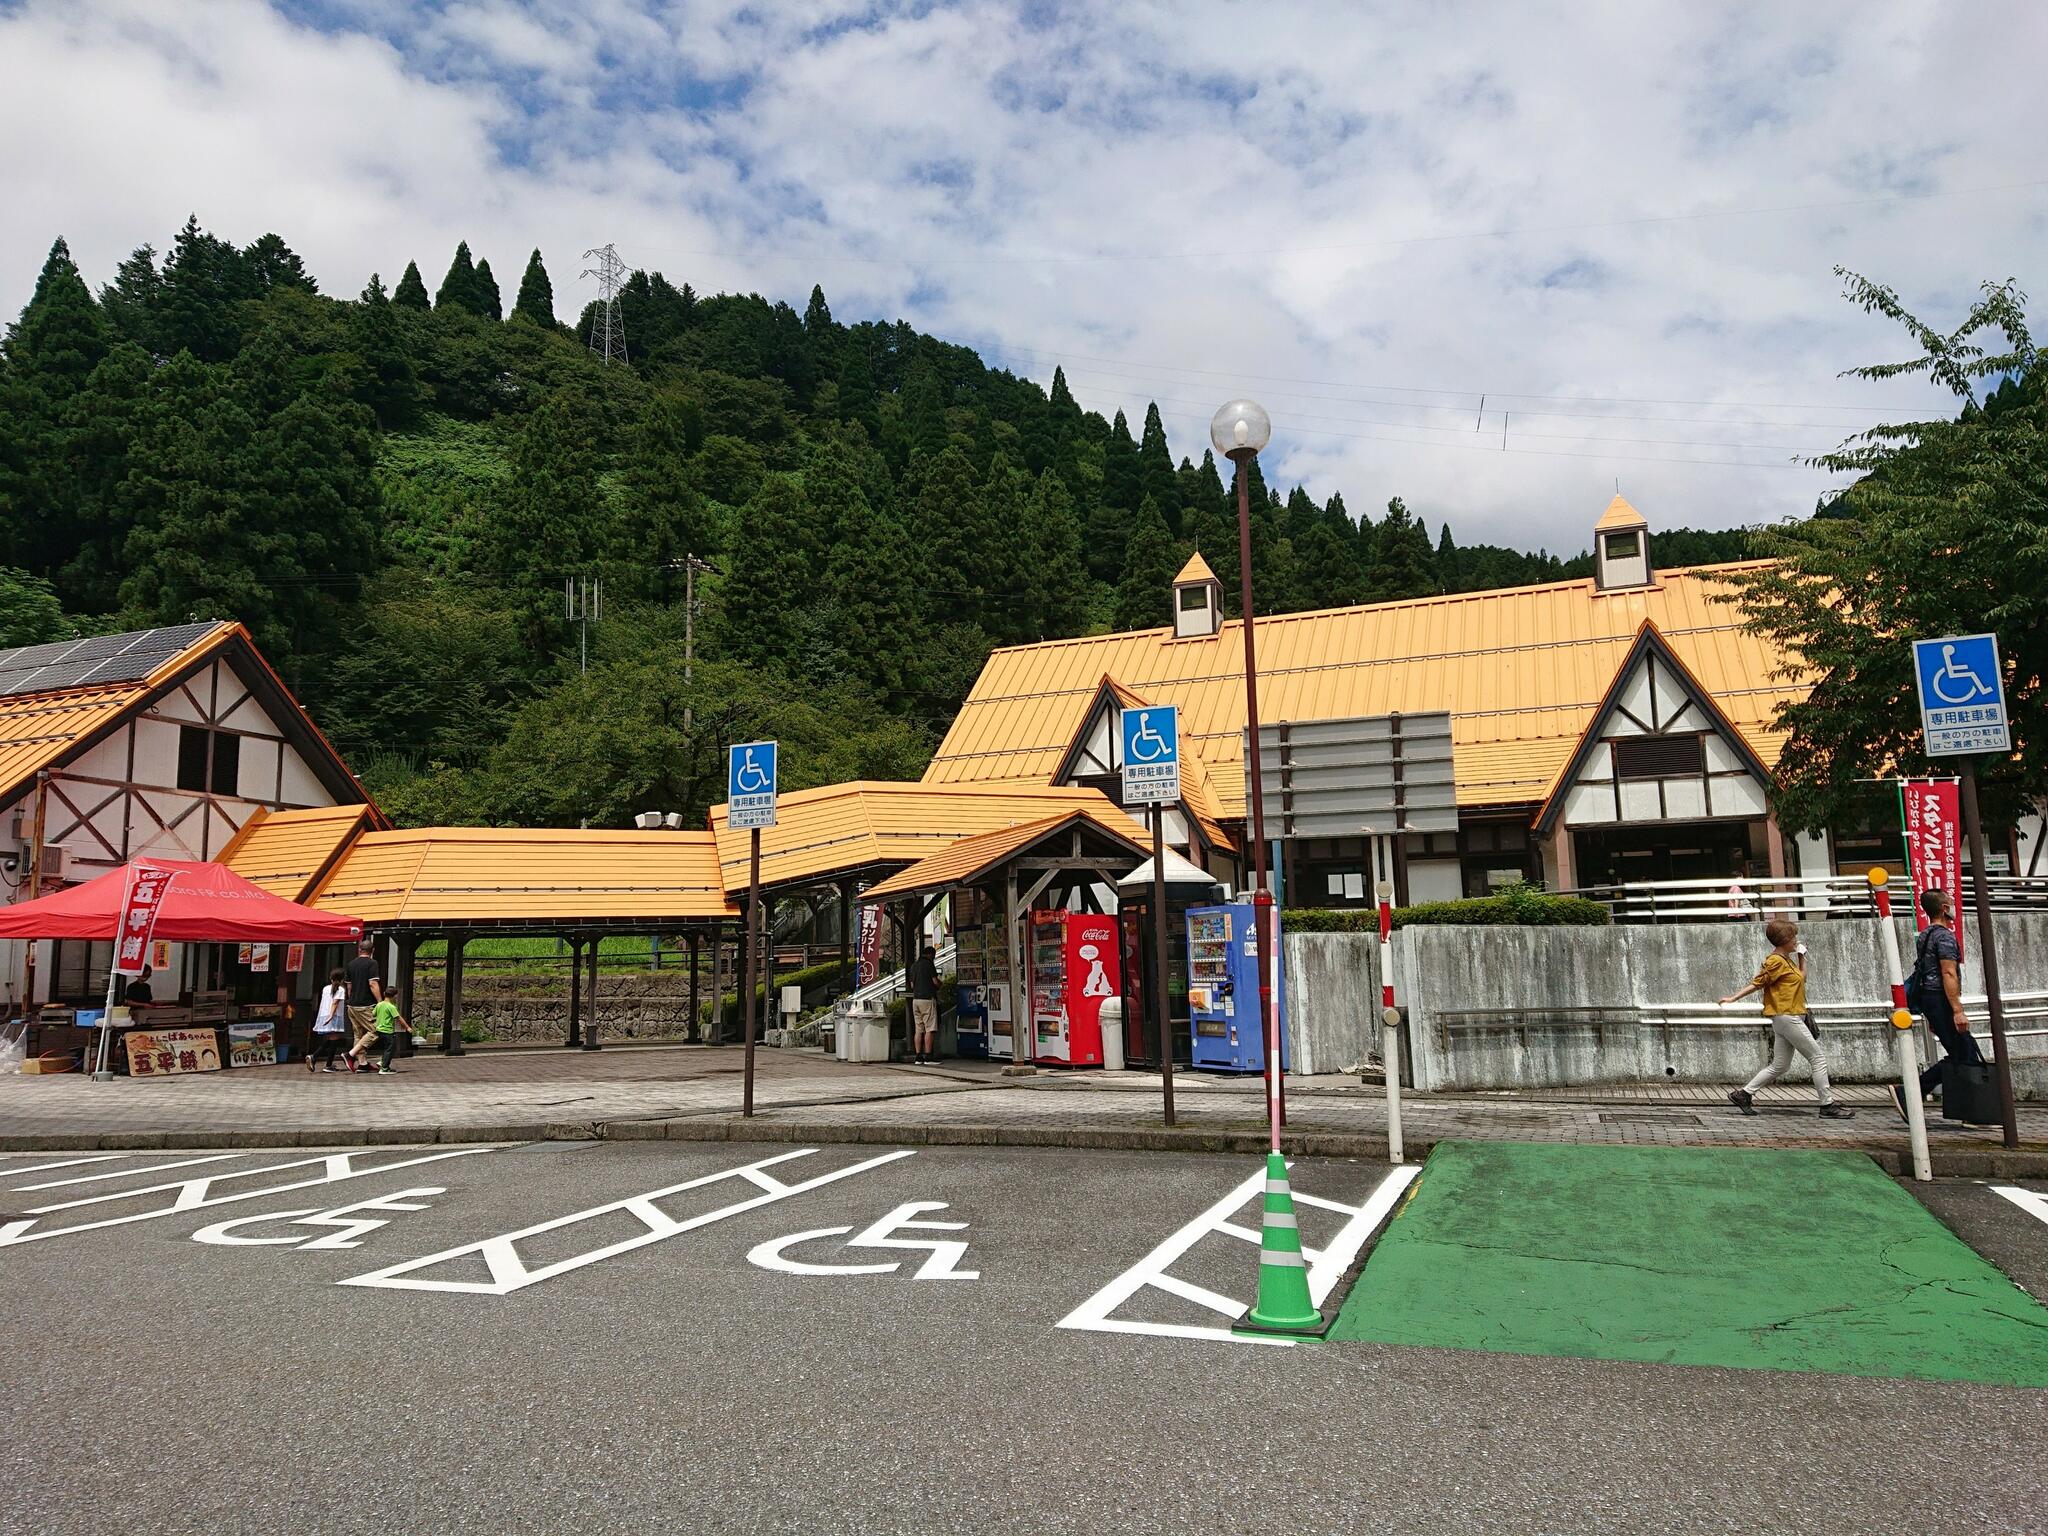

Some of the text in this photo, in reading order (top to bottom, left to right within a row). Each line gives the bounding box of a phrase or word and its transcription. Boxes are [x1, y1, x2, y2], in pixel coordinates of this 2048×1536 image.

[1931, 708, 1999, 725] 専用駐車場
[1932, 728, 2001, 739] 一般の方の駐車
[1933, 738, 2003, 750] はご遠慮下さい
[1128, 766, 1173, 778] 専用駐車場
[733, 796, 771, 807] 専用駐車場
[122, 882, 157, 960] 五平餅
[867, 929, 876, 954] ソフト
[1081, 928, 1110, 941] Coca-Cola
[860, 928, 869, 961] クリーム
[133, 1049, 198, 1073] 五平餅
